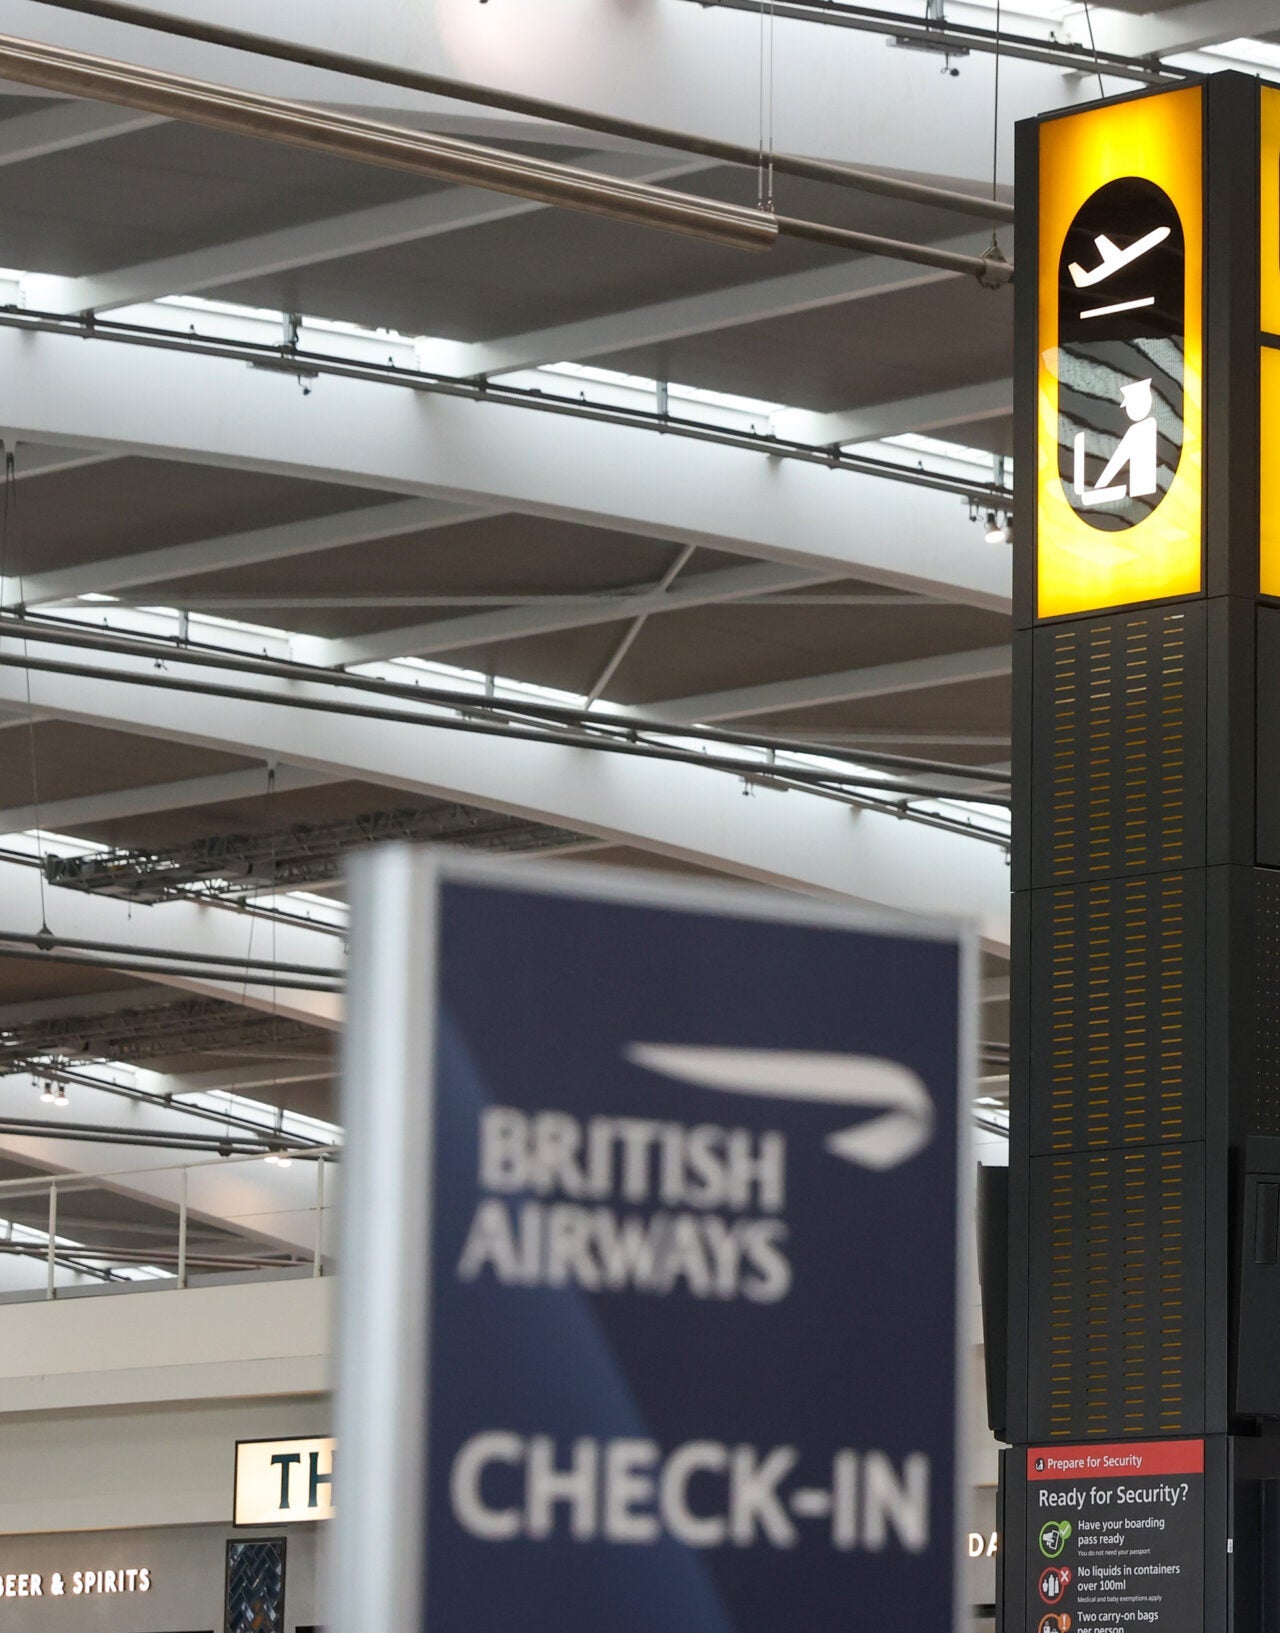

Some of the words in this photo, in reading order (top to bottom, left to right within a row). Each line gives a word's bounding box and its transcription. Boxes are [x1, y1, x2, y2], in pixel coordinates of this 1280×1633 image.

[475, 1103, 788, 1215] BRITISH
[454, 1199, 795, 1306] AIRWAYS
[1047, 1457, 1085, 1471] Prepare
[1087, 1455, 1101, 1467] for
[1103, 1453, 1143, 1469] Security
[448, 1427, 932, 1555] CHECK-IN
[1038, 1487, 1086, 1510] Ready
[1089, 1486, 1114, 1505] for
[1116, 1483, 1190, 1507] Security?
[1078, 1520, 1101, 1531] Have
[1102, 1520, 1124, 1533] your
[1124, 1516, 1166, 1530] boarding
[1078, 1535, 1098, 1547] pass
[1099, 1532, 1125, 1547] ready
[1077, 1566, 1091, 1577] No
[1092, 1564, 1122, 1579] liquids
[1123, 1564, 1132, 1576] in
[1133, 1563, 1181, 1575] containers
[50, 1572, 64, 1596] &
[72, 1568, 151, 1595] SPIRITS
[1077, 1582, 1098, 1592] over
[1099, 1579, 1126, 1591] 100ml
[1077, 1611, 1097, 1622] Two
[1098, 1611, 1136, 1624] carry-on
[1137, 1609, 1159, 1623] bags
